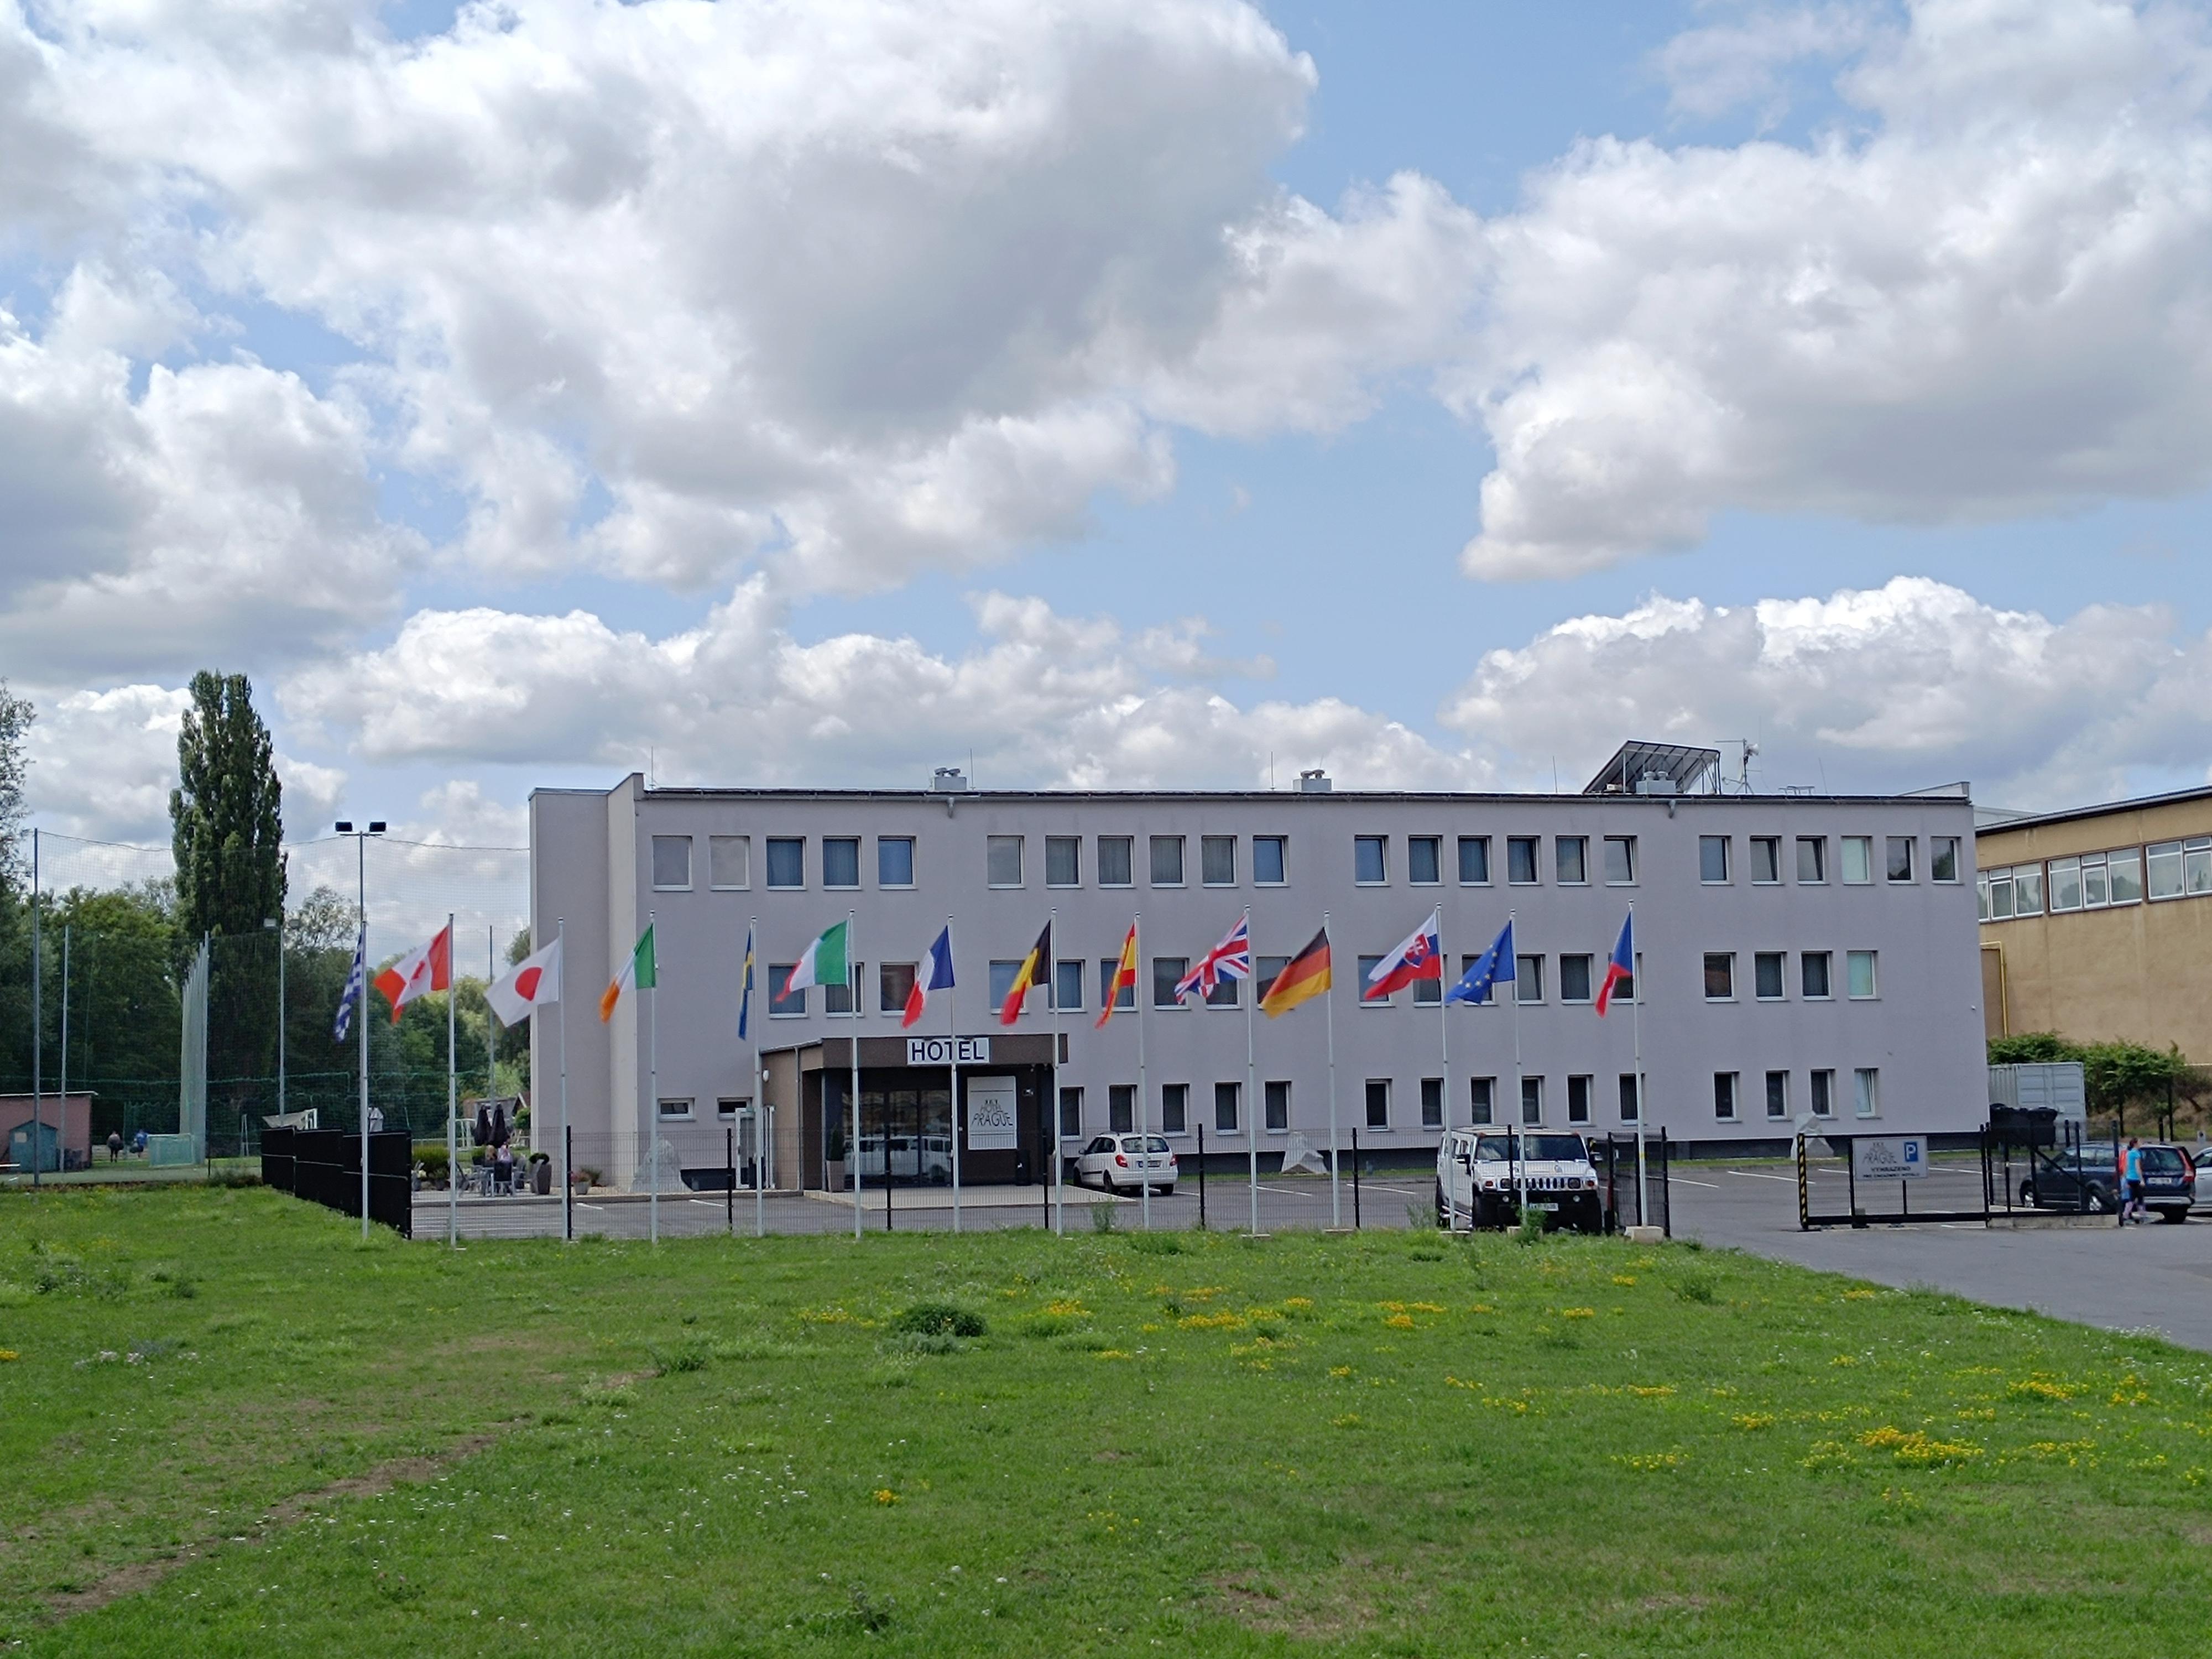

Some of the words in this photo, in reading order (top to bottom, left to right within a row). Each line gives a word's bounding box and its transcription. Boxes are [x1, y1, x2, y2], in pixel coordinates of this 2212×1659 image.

[912, 1041, 984, 1061] HOTEL
[971, 1112, 1013, 1126] PRAGUE
[1906, 1144, 1917, 1160] P
